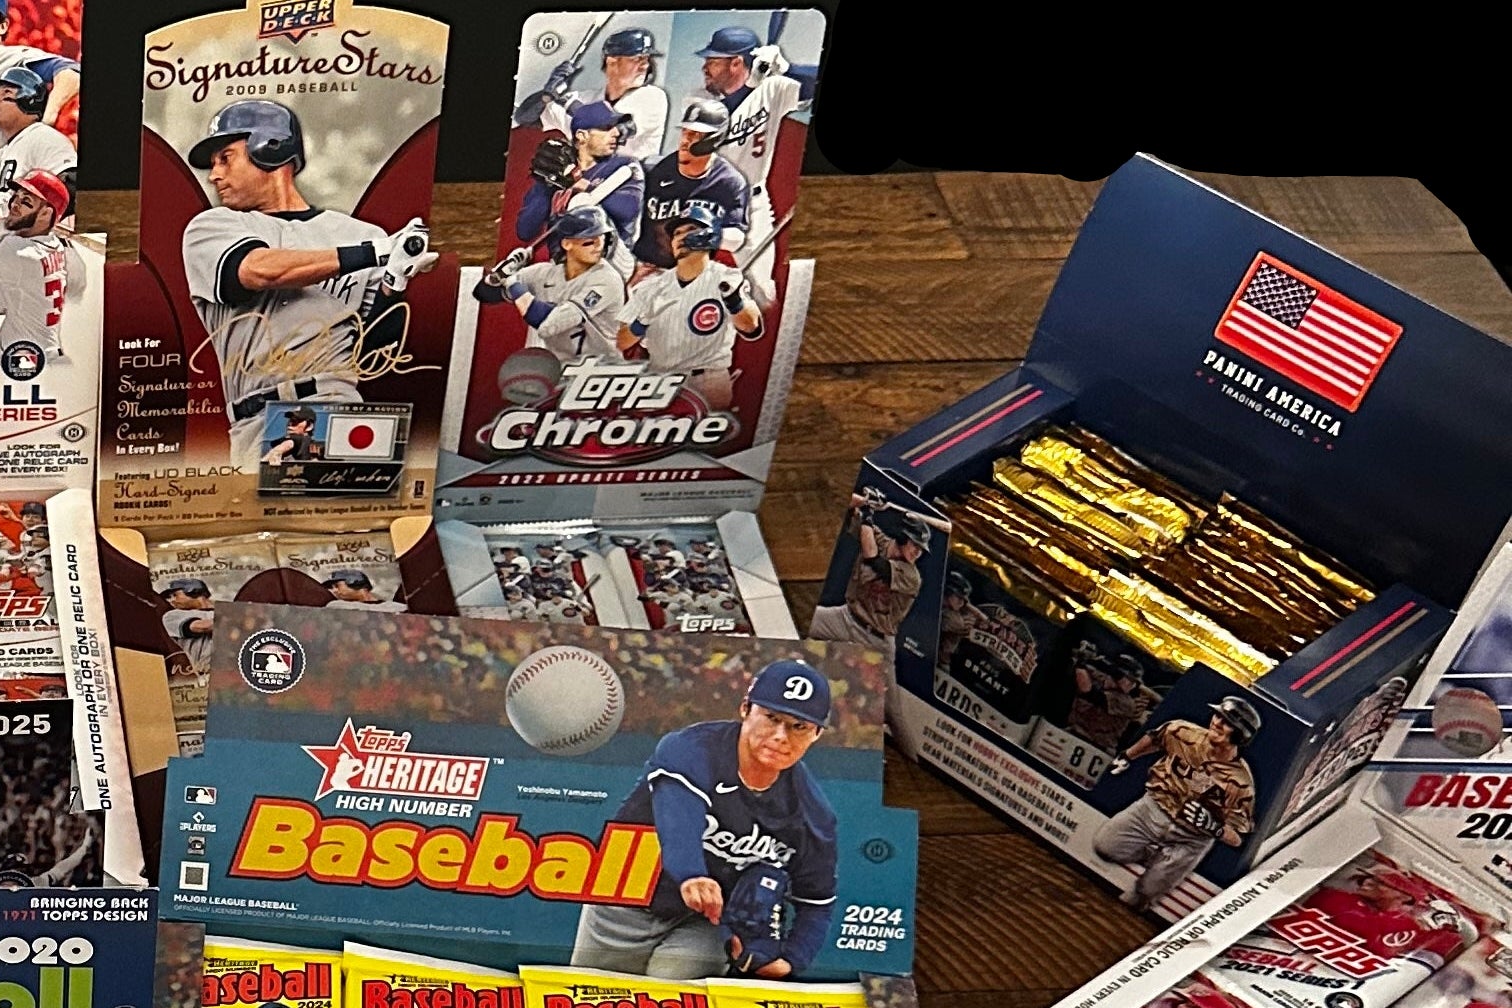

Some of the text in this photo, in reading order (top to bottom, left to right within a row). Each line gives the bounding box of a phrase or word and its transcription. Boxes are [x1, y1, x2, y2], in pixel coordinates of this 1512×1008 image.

[226, 82, 359, 96] 2009 BASEBALL
[119, 338, 161, 350] Look For
[119, 353, 181, 369] FOUR
[1202, 349, 1344, 437] PANINI AMERICA
[117, 402, 224, 419] Memorabilia
[1221, 382, 1263, 416] TRADING
[1262, 409, 1292, 430] CARD
[491, 410, 728, 451] Chrome
[154, 468, 179, 480] UD
[185, 465, 243, 479] BLACK
[556, 472, 625, 483] UPDATE
[636, 470, 701, 481] SERIES
[970, 629, 1023, 670] STRIPES
[67, 544, 112, 810] ONE AUTOGRAPH OR ONE RELIC CARD
[361, 755, 482, 798] HERITAGE
[562, 789, 608, 799] Yamamoto
[335, 795, 474, 819] HIGH NUMBER
[233, 799, 664, 902] Baseball
[30, 897, 149, 909] BRINGING BACK
[2, 910, 38, 921] 1971
[42, 910, 88, 921] TOPPS
[93, 910, 148, 921] DESIGN
[844, 905, 904, 925] 2024
[840, 923, 906, 939] TRADING
[836, 937, 887, 952] CARDS
